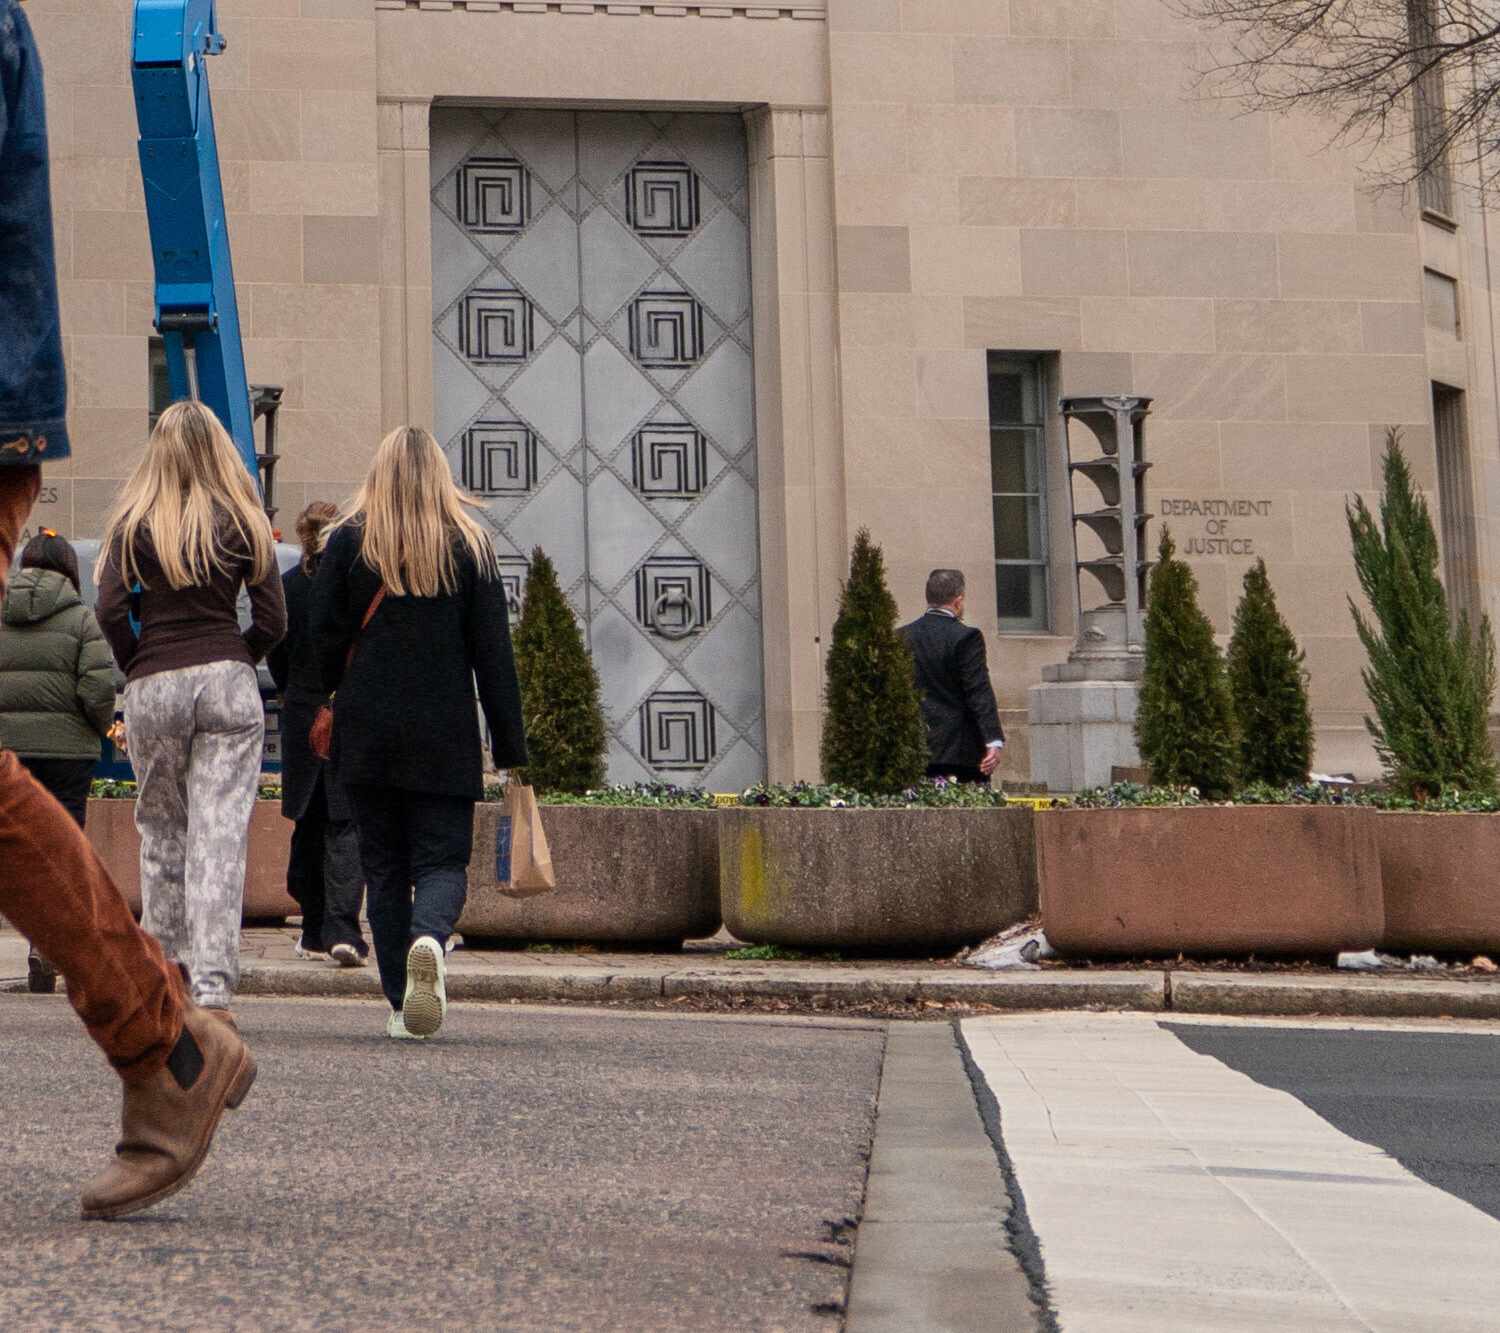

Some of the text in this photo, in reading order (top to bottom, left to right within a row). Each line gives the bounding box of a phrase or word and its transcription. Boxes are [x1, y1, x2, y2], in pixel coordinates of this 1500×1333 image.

[1161, 499, 1272, 516] DEPARTMENT
[1206, 519, 1228, 534] OF
[1184, 538, 1254, 555] JUSTICE
